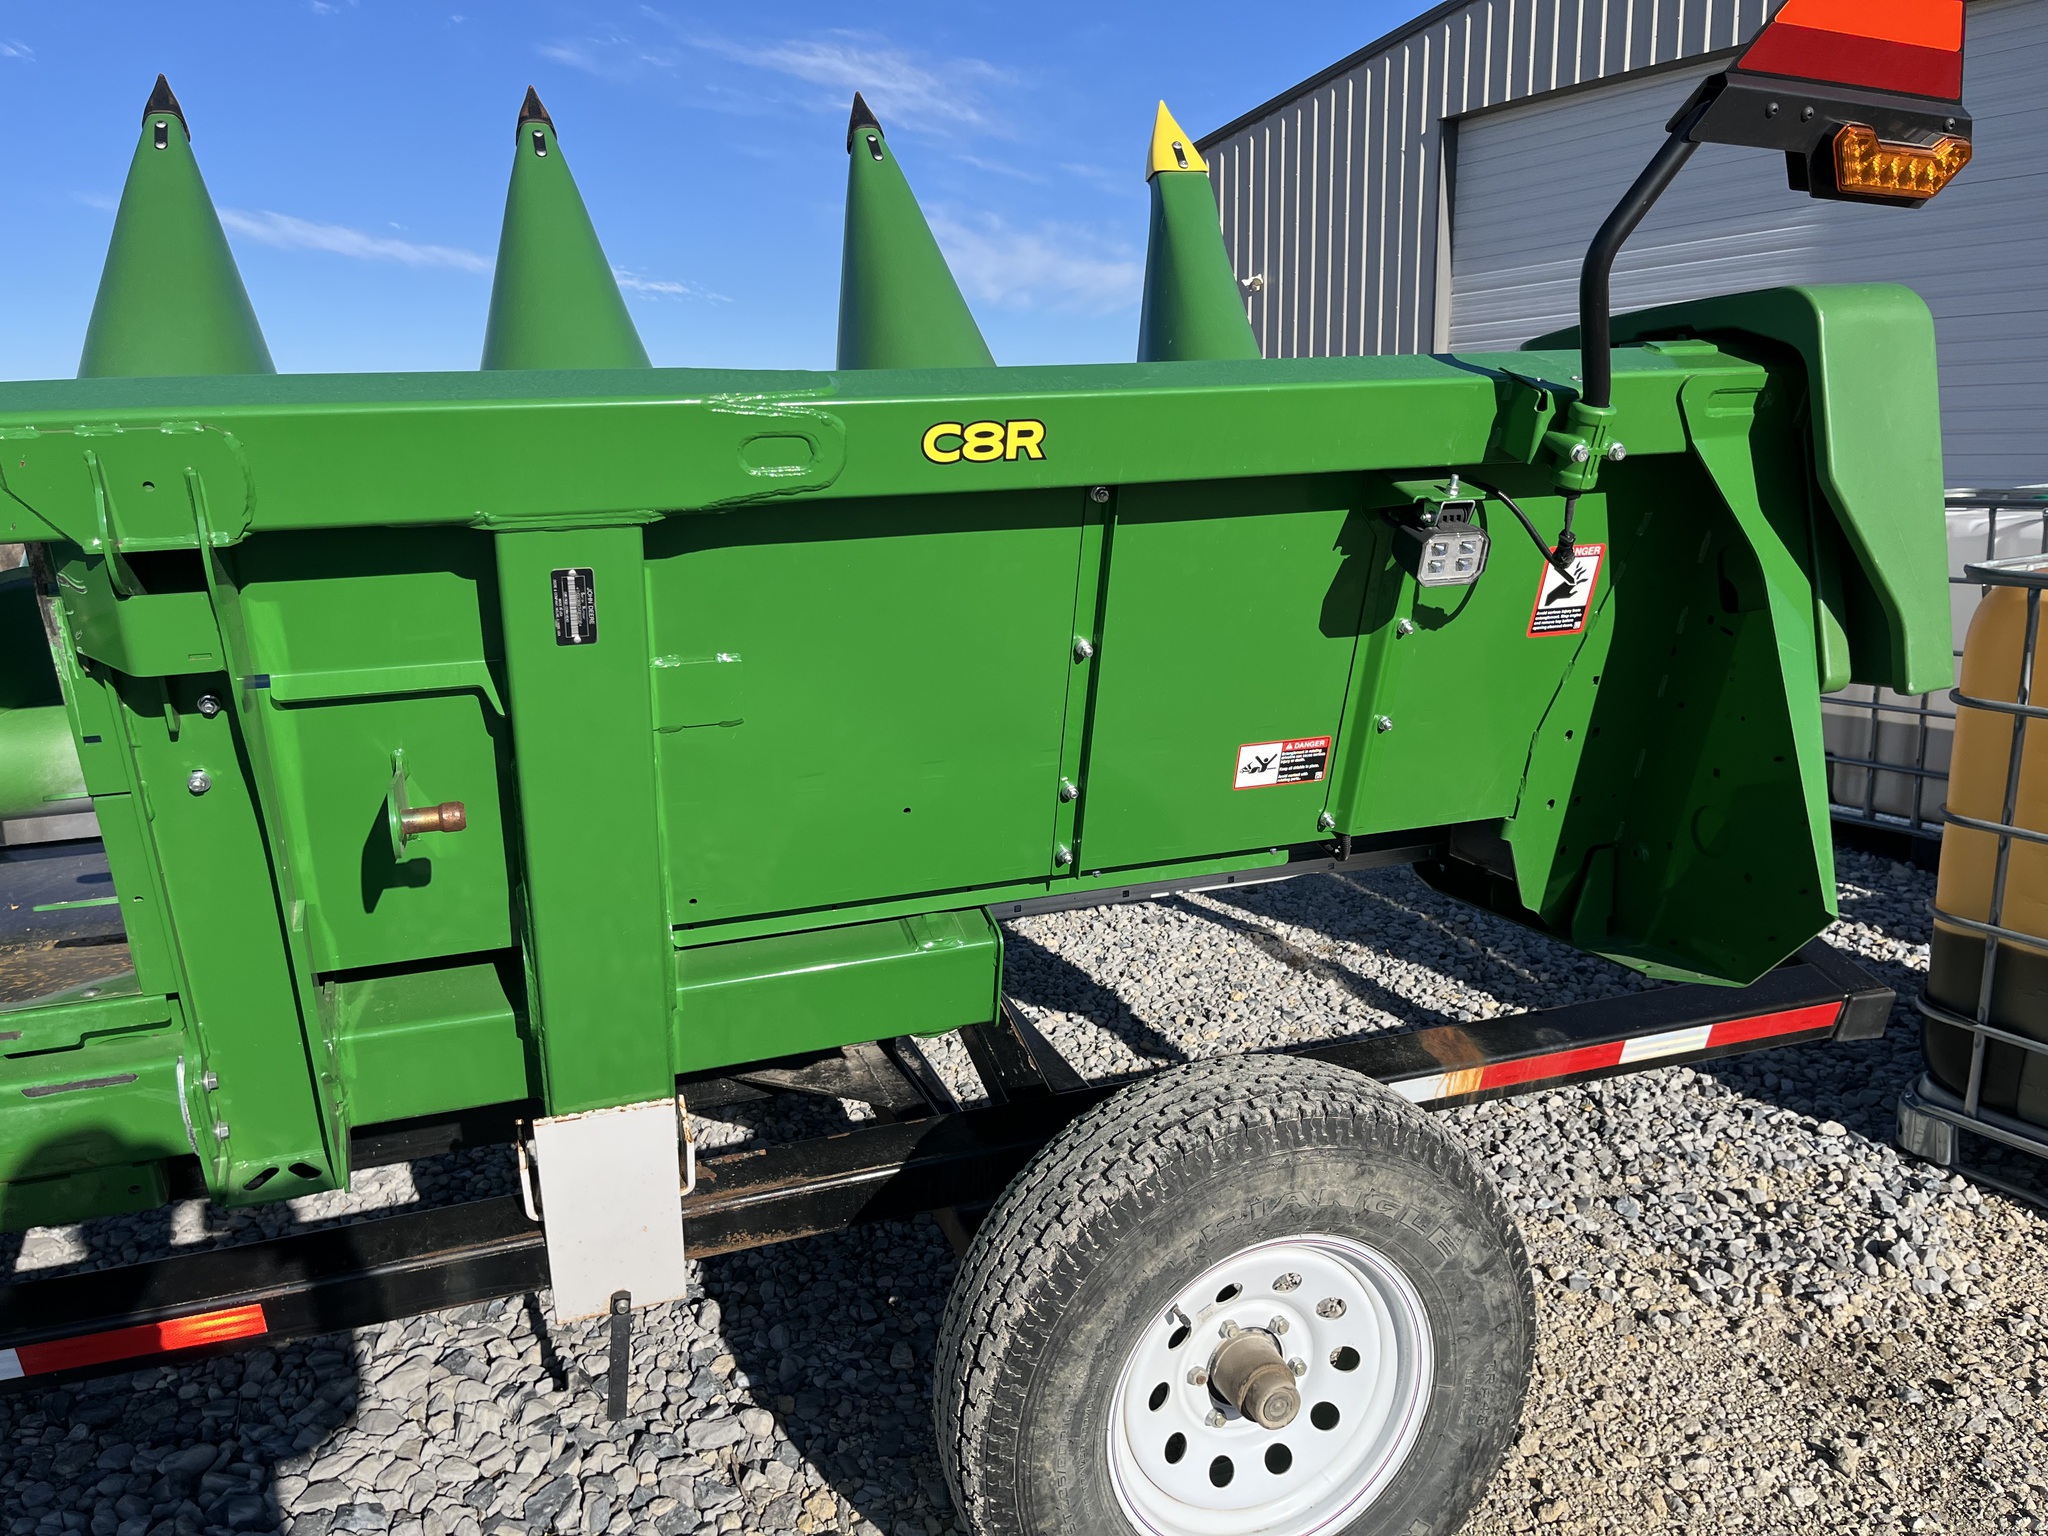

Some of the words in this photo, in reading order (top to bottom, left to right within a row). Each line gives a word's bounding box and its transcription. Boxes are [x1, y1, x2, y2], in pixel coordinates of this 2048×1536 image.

[921, 419, 1047, 464] C8R
[1573, 546, 1601, 556] NGER
[1294, 740, 1325, 749] DANGER
